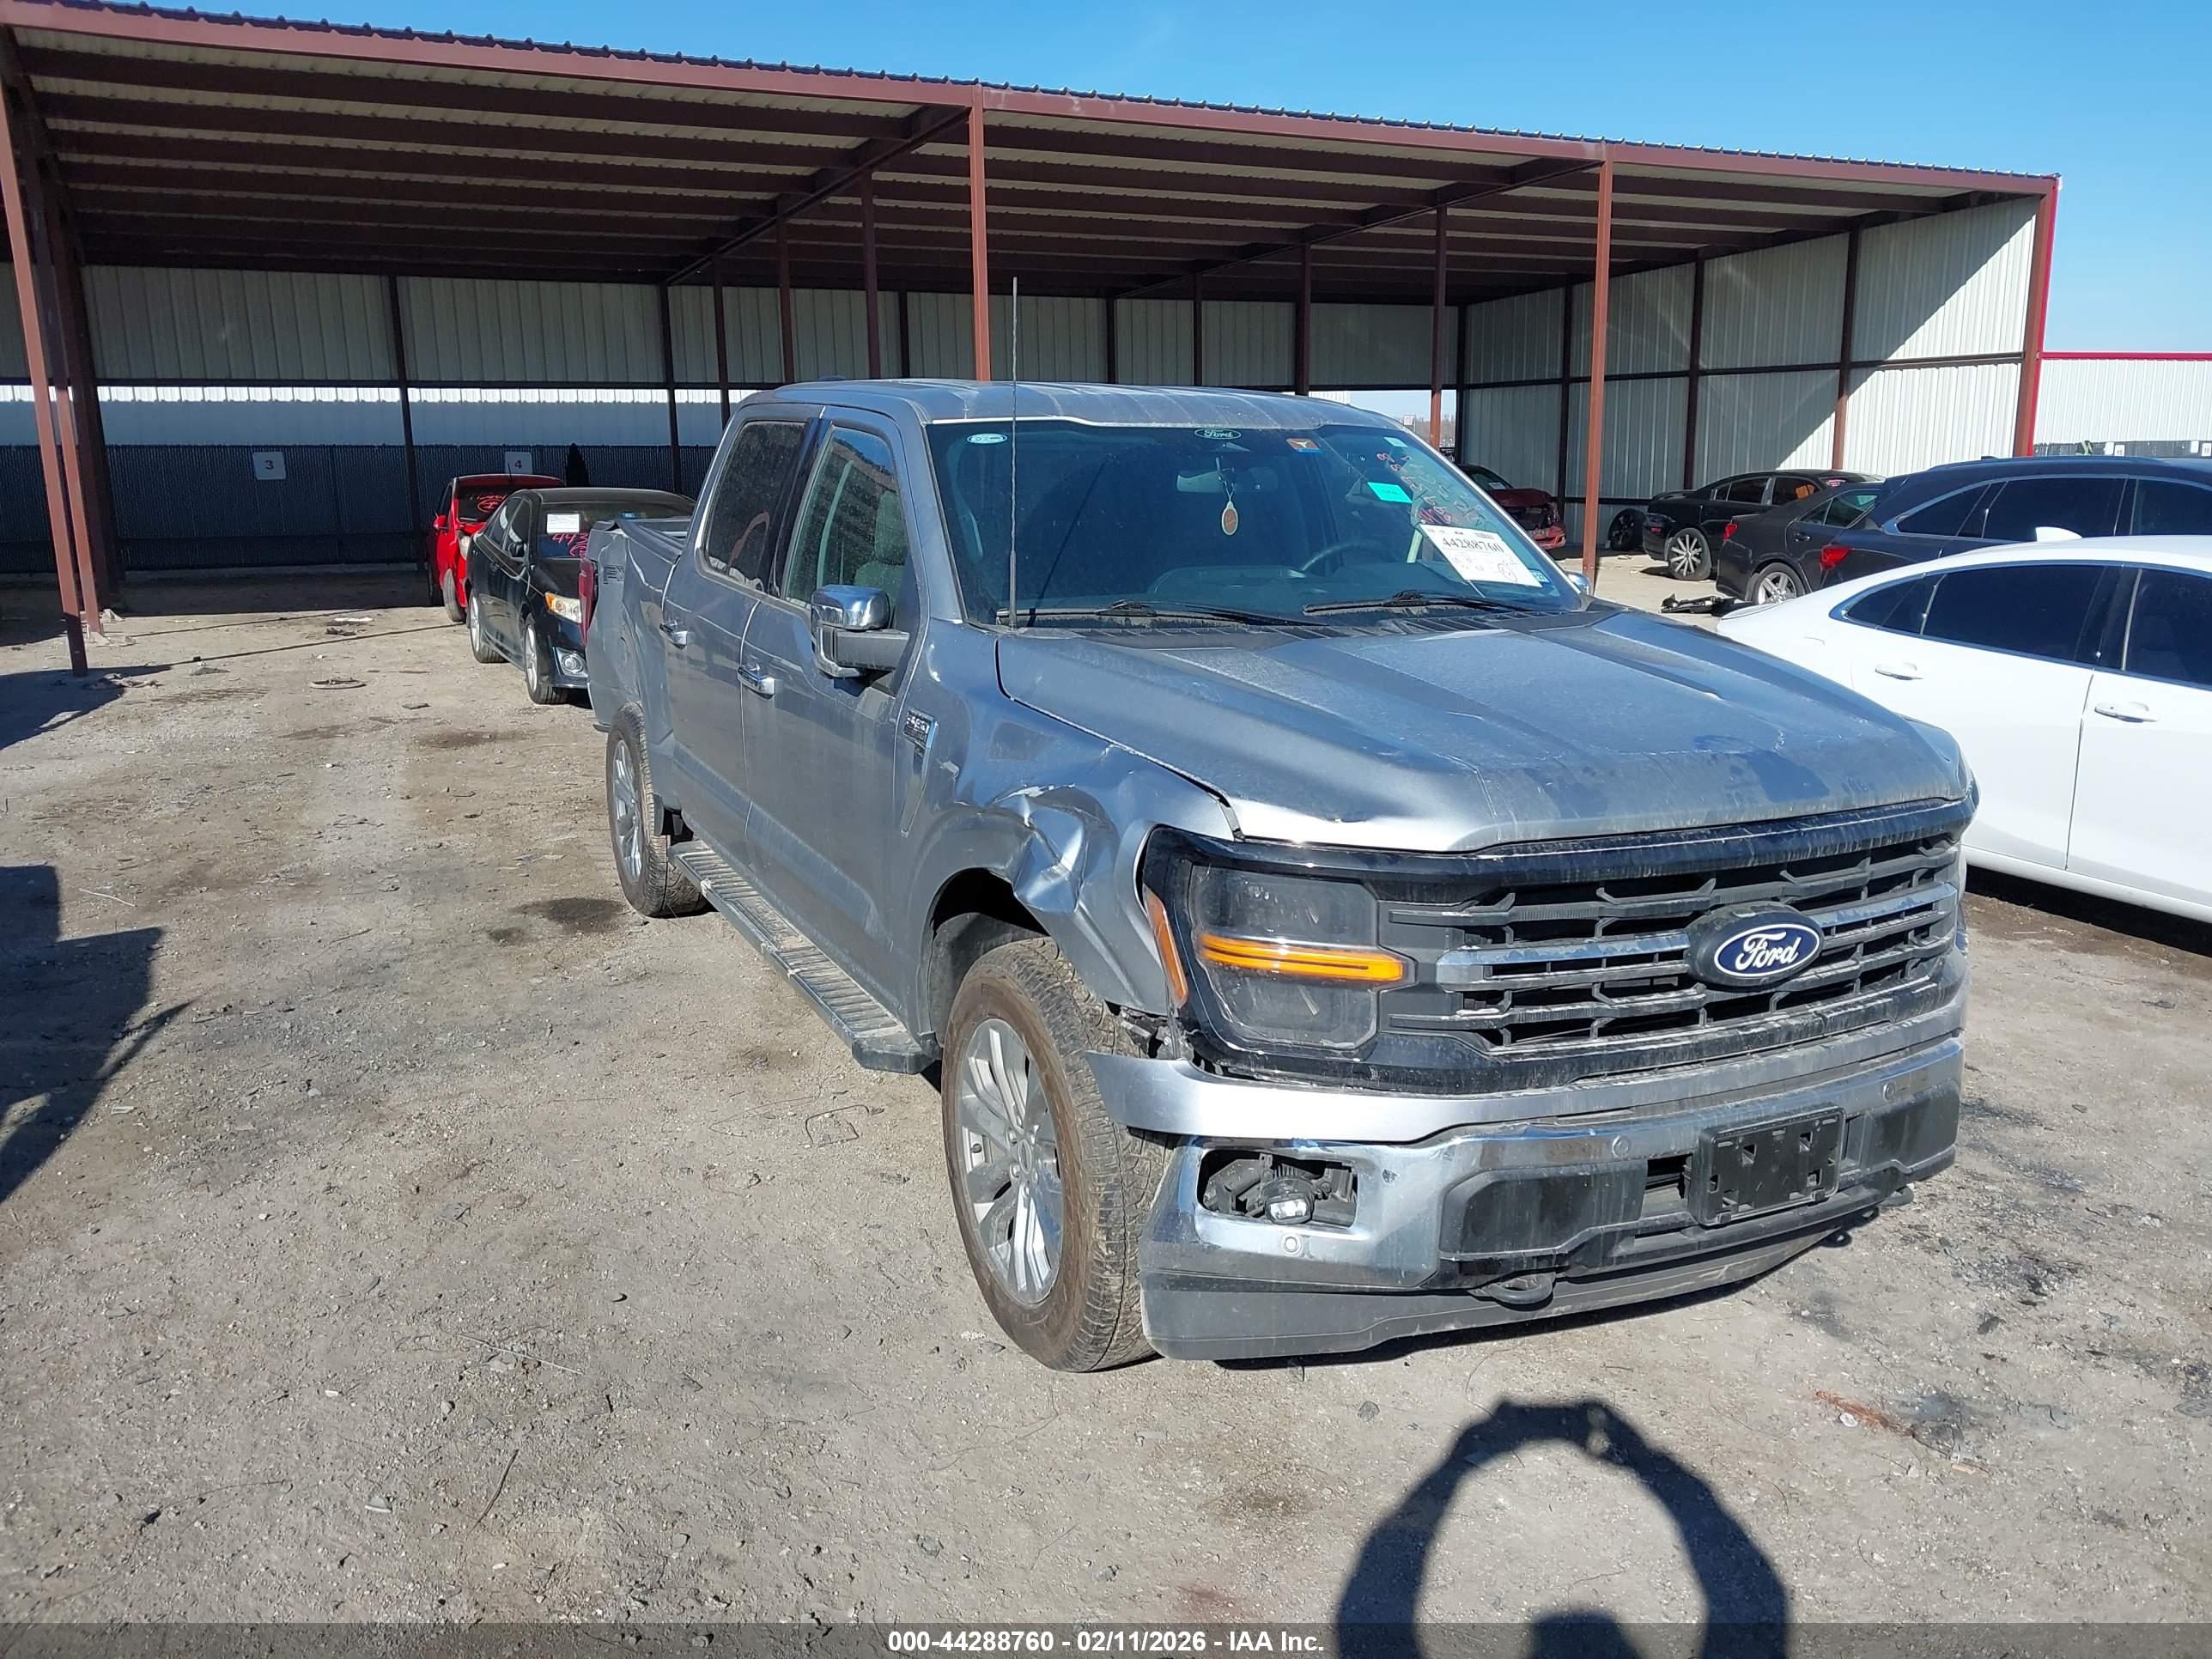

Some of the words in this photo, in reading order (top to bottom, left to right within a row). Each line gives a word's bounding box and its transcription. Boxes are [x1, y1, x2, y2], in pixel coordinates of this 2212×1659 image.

[1204, 429, 1234, 438] Ford
[264, 459, 275, 470] 3
[514, 459, 523, 470] 4
[1443, 538, 1504, 553] 44288760
[1735, 931, 1802, 971] Ford
